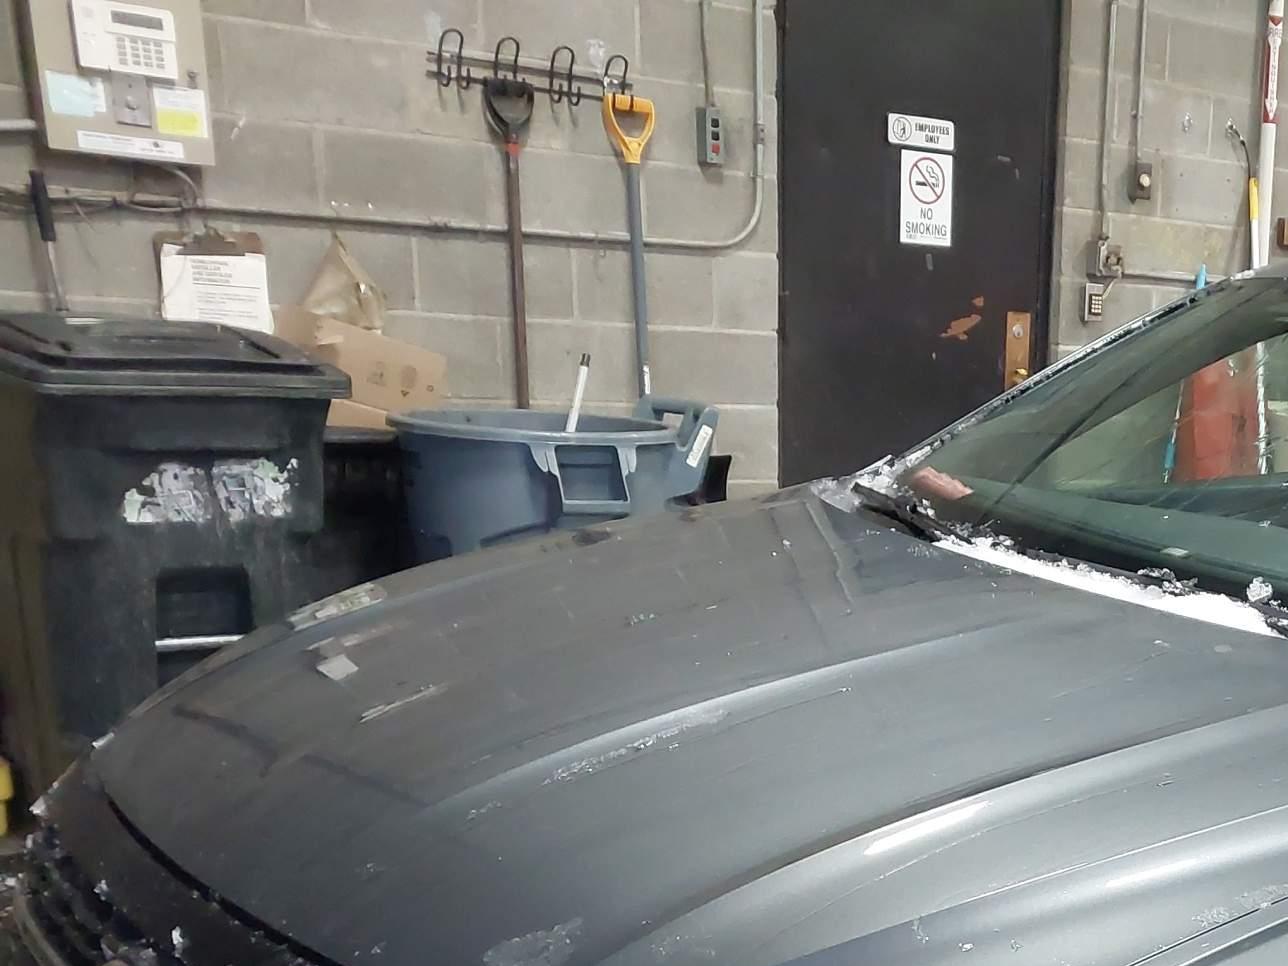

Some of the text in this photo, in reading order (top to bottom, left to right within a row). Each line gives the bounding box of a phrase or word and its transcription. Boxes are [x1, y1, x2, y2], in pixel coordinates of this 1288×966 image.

[914, 122, 950, 136] EMPLOYEES
[924, 134, 940, 145] ONLY
[920, 207, 934, 220] NO
[905, 220, 948, 237] SMOKING
